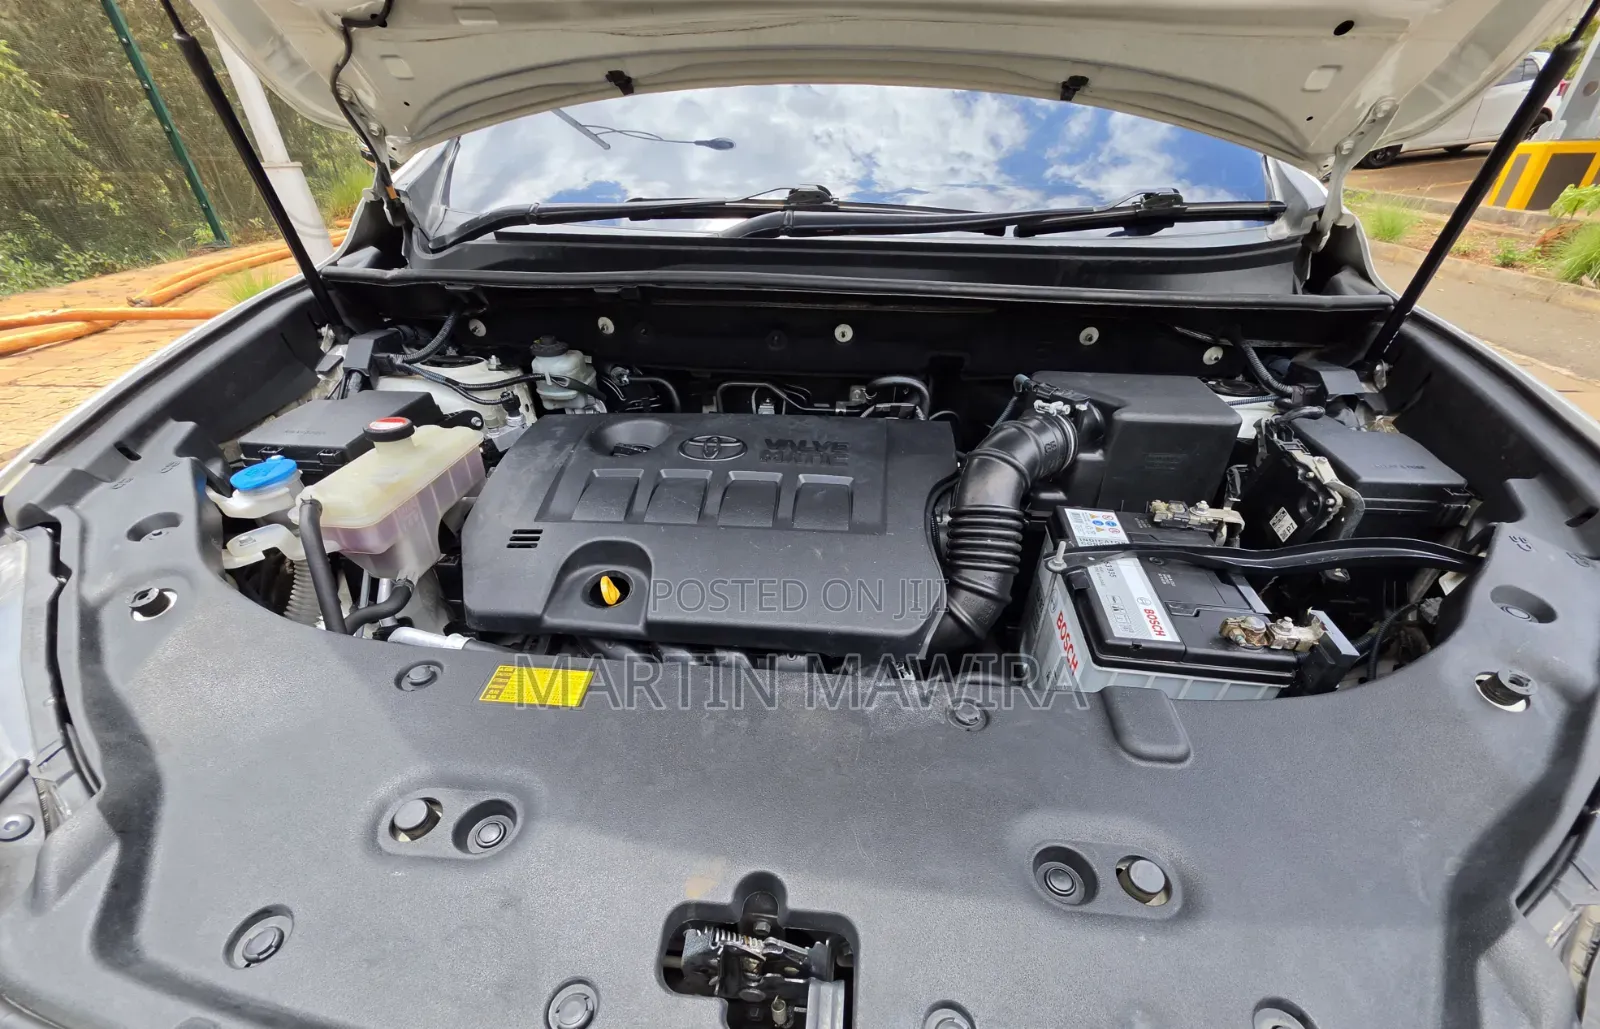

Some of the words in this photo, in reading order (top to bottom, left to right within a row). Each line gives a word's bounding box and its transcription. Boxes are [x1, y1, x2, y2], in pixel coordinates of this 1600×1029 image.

[764, 438, 851, 453] VALVE
[1143, 608, 1166, 637] BOSCH
[1056, 611, 1079, 676] BOSCH
